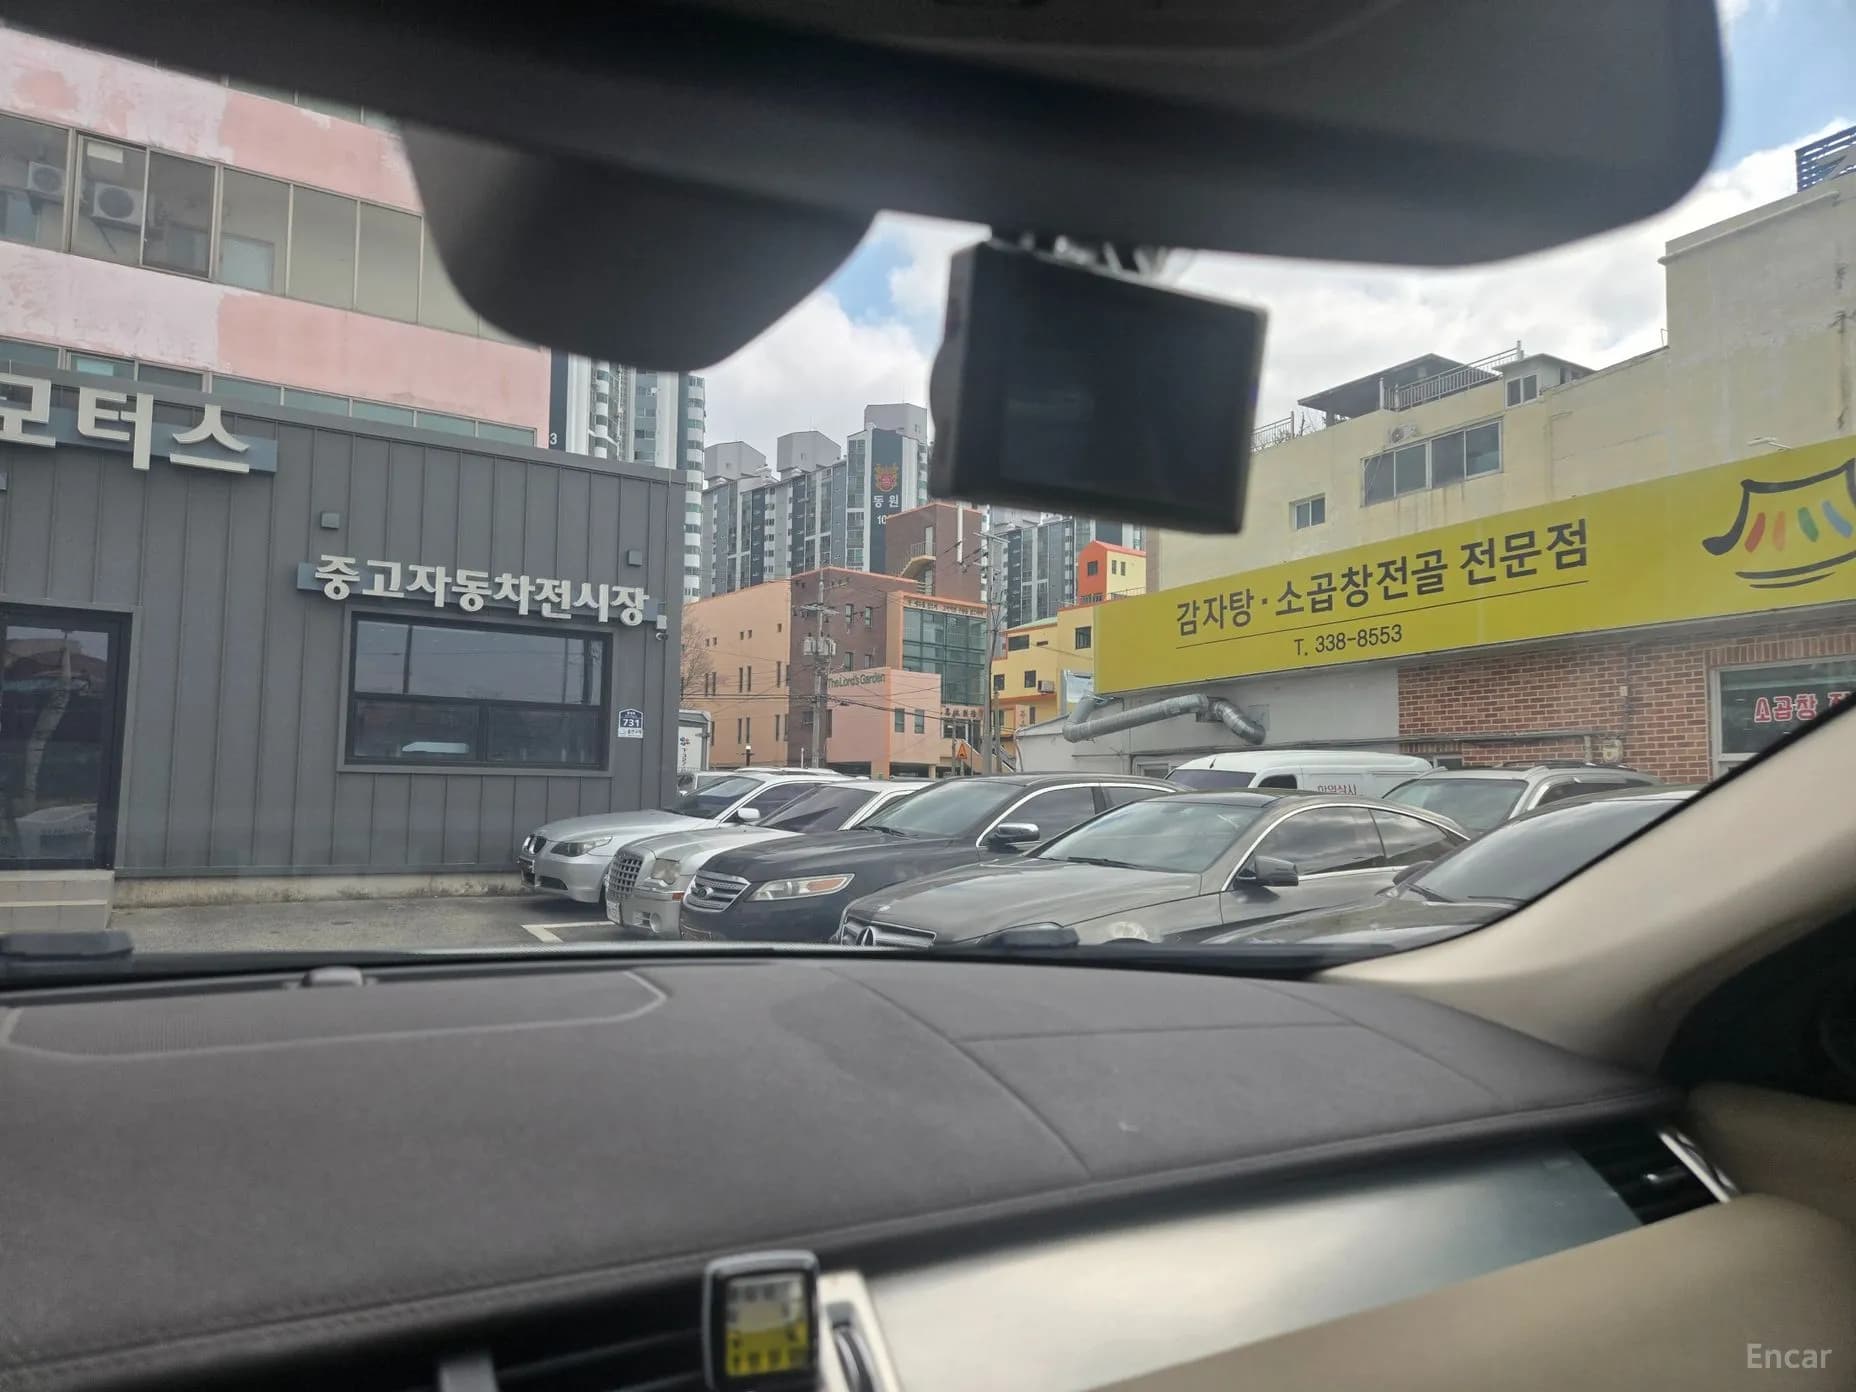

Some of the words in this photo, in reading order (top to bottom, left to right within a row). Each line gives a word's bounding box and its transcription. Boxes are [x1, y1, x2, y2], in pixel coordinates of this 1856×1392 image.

[1460, 518, 1588, 586] 전문점
[314, 554, 650, 627] 중고자동차전시장
[1315, 624, 1403, 654] 338-8553
[860, 672, 886, 685] Garden
[622, 718, 640, 727] 731
[1754, 693, 1818, 723] 소곱창
